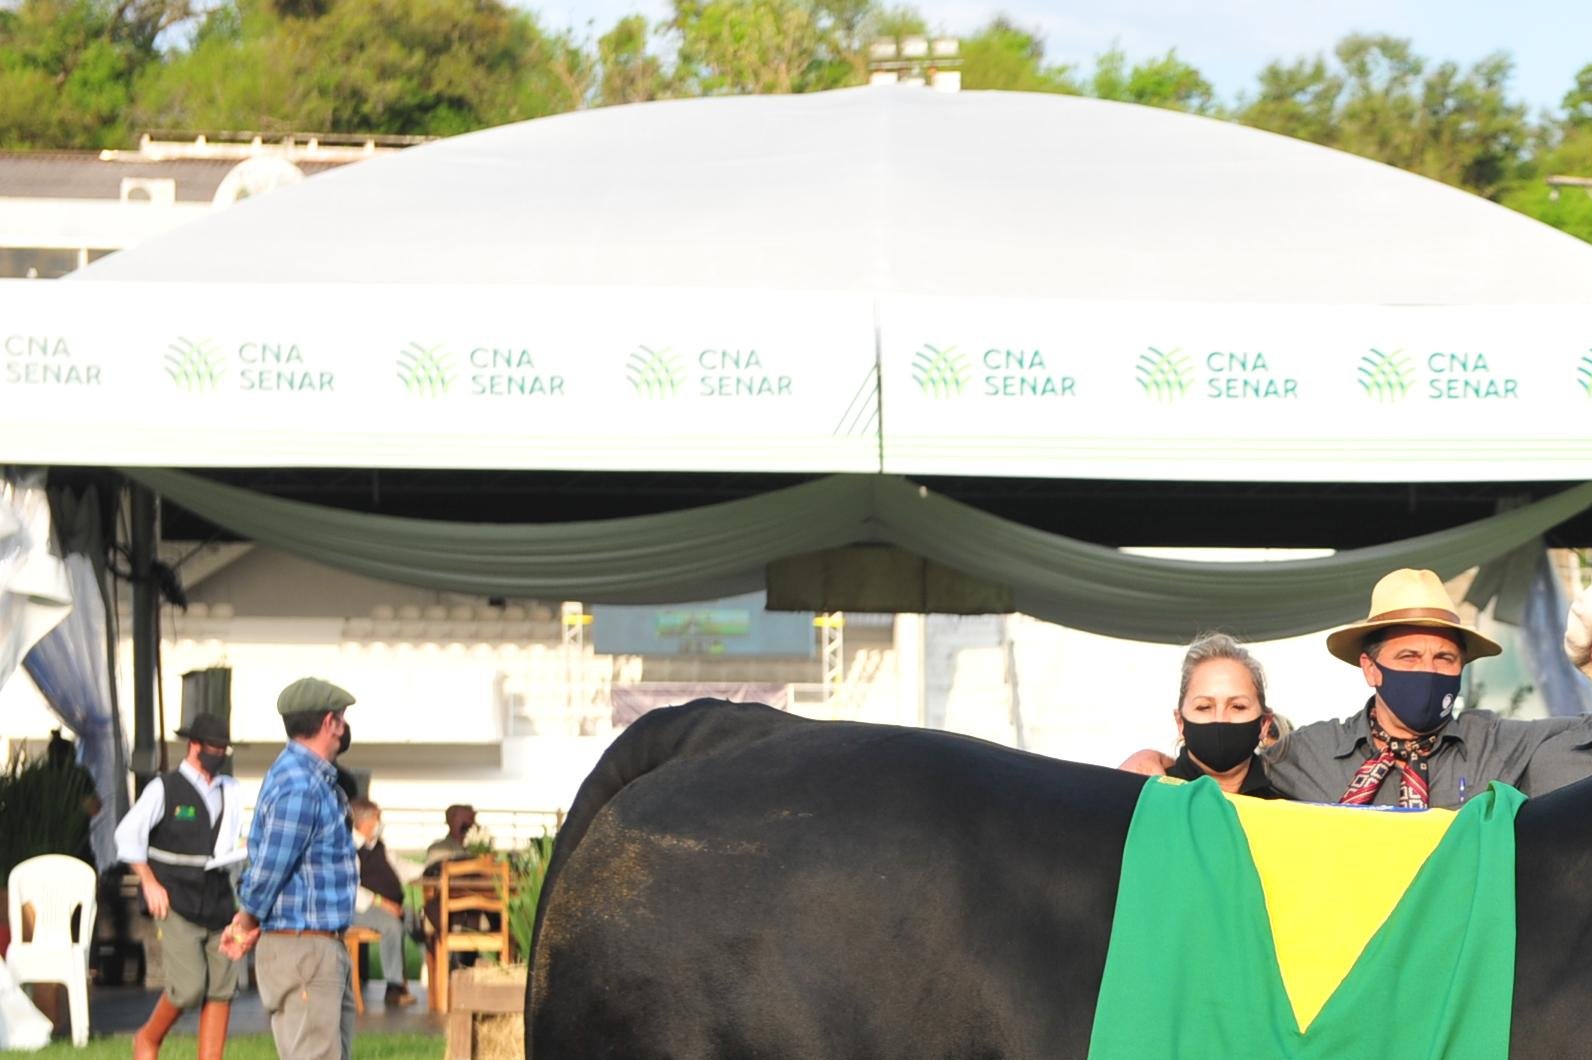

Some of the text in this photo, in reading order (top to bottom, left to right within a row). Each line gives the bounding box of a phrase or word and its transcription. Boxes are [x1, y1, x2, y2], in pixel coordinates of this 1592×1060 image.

[6, 338, 70, 357] CNA
[240, 344, 304, 364] CNA
[471, 349, 535, 369] CNA
[700, 351, 762, 370] CNA
[984, 349, 1047, 371] CNA
[1207, 353, 1270, 374] CNA
[1429, 353, 1490, 374] CNA
[8, 365, 101, 385] SENAR
[242, 371, 335, 391] SENAR
[473, 376, 565, 396] SENAR
[702, 377, 792, 397] SENAR
[986, 376, 1077, 397] SENAR
[1209, 378, 1298, 399] SENAR
[1430, 379, 1519, 401] SENAR
